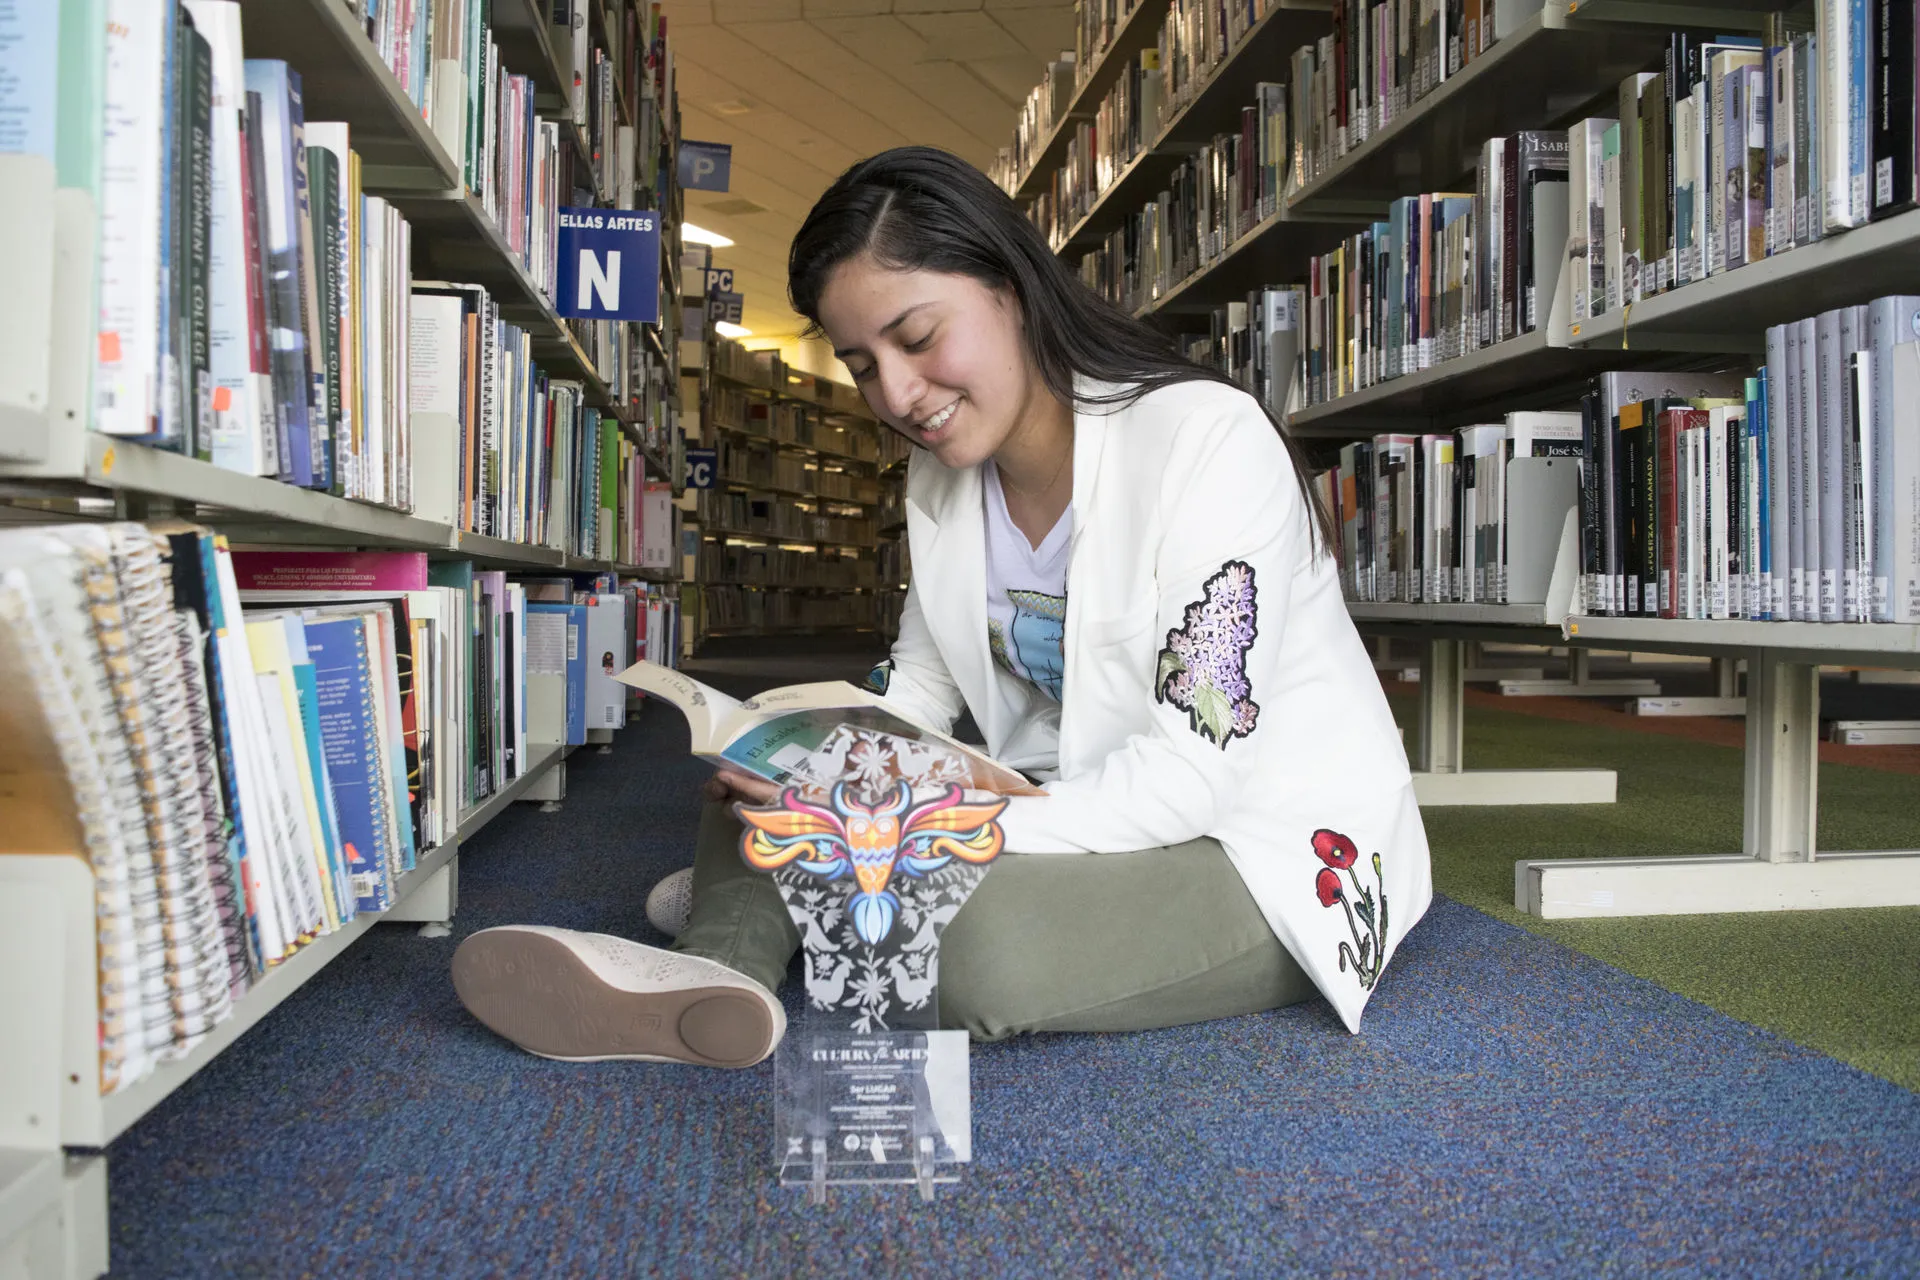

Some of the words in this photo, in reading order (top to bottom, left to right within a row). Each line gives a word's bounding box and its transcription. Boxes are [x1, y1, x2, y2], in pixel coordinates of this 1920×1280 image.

[1796, 69, 1804, 96] Great
[1796, 98, 1805, 164] Expectations
[694, 156, 714, 184] P
[192, 126, 204, 263] DEVELOPMENT
[560, 214, 603, 229] ELLAS
[607, 217, 652, 231] ARTES
[326, 224, 338, 332] DEVELOPMENT
[578, 249, 621, 311] N
[708, 271, 732, 292] PC
[193, 284, 205, 366] COLLEGE
[711, 302, 740, 322] PE
[328, 350, 339, 415] COLLEGE
[1547, 446, 1570, 457] José
[1646, 456, 1654, 502] MANADA
[1646, 523, 1654, 564] FUERZA
[746, 747, 763, 758] El
[763, 727, 800, 748] alcalde
[866, 1084, 896, 1094] LUGAR
